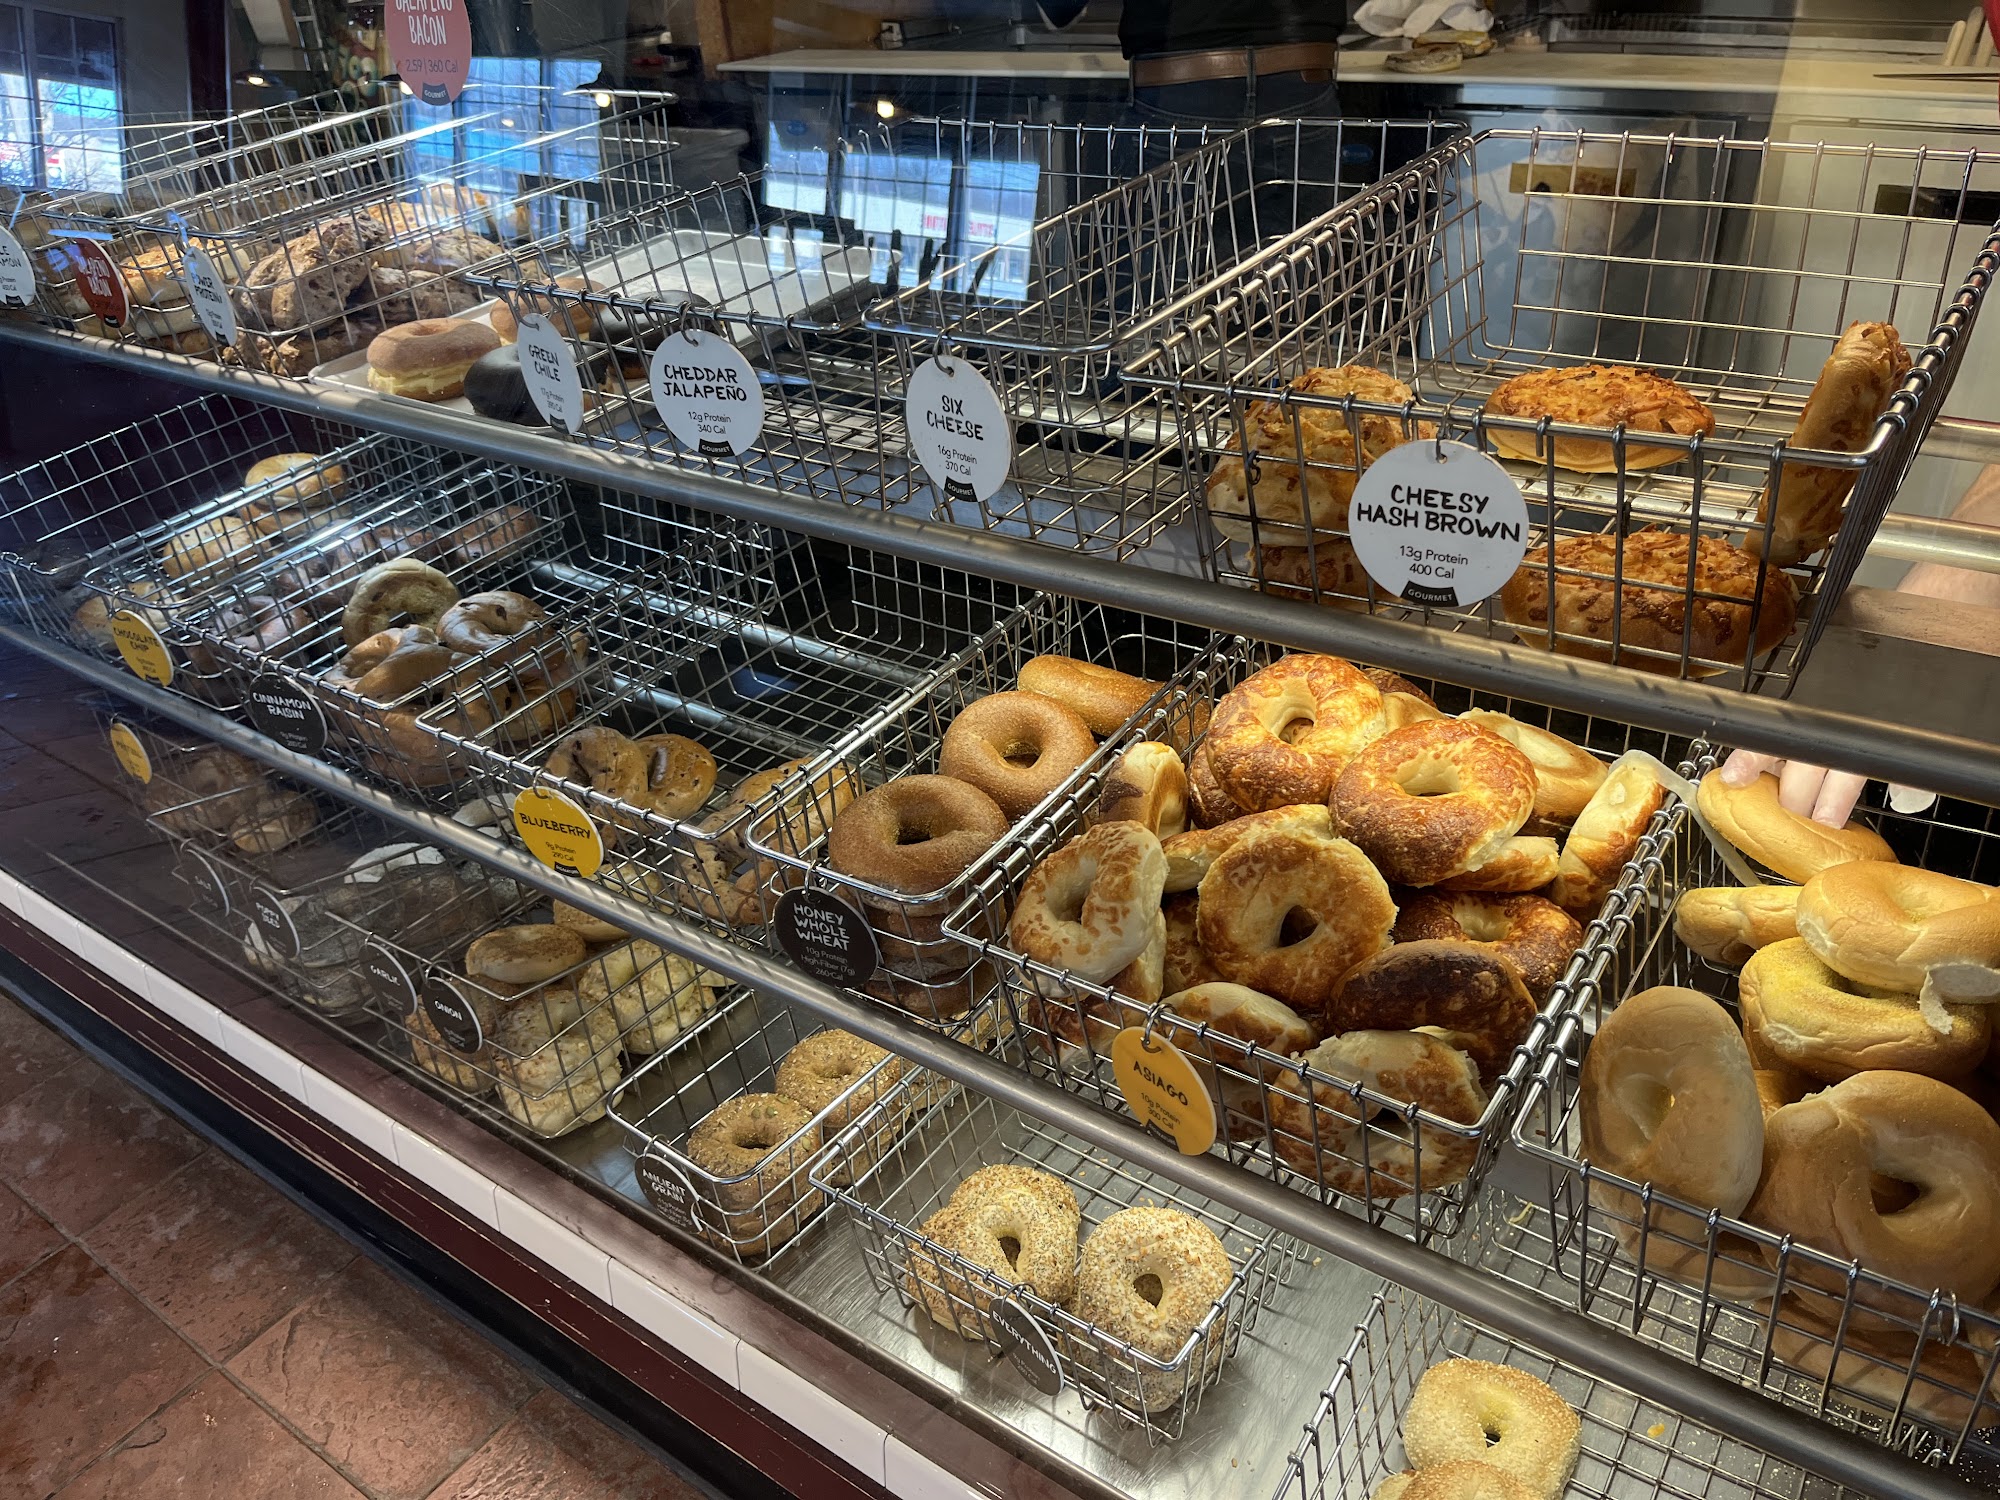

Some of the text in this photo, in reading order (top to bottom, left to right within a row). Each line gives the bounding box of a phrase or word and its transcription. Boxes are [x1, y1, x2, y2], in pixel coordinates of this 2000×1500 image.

[408, 14, 447, 46] BACON
[528, 344, 559, 366] GREEN
[534, 361, 560, 382] CHILE
[664, 364, 738, 384] CHEDDAR
[663, 382, 747, 401] JALAPEÑO
[941, 394, 964, 417] SIX
[688, 411, 731, 423] 12g Protein
[926, 410, 984, 441] CHEESE
[697, 424, 726, 435] 340 Cal
[701, 444, 730, 453] GOURMET
[937, 444, 978, 465] 16g Protein
[945, 460, 972, 476] 370 Cal
[947, 482, 973, 495] GOURMET
[1390, 484, 1489, 515] CHEESY
[1357, 502, 1520, 542] HASH BROWN
[1399, 545, 1468, 565] 13g Protein
[1409, 563, 1455, 579] 400 Cal
[1407, 588, 1452, 602] GOURMET
[252, 692, 312, 711] CINNAMON
[267, 704, 304, 720] RAISIN
[519, 812, 590, 839] BLUEBERRY
[555, 844, 576, 854] Protein
[793, 902, 843, 925] HONEY
[793, 914, 850, 939] WHOLE
[795, 927, 850, 951] WHEAT
[805, 946, 847, 963] 10g Protein
[370, 965, 400, 986] GARLIC
[830, 972, 844, 981] Cal
[434, 1000, 462, 1021] ONION
[1133, 1060, 1188, 1106] ASIAGO
[1141, 1092, 1180, 1125] 10g Protein
[1162, 1117, 1174, 1130] Cal
[642, 1168, 685, 1196] ANCIENT
[651, 1181, 684, 1204] GRAIN
[992, 1310, 1057, 1374] EVERYTHING
